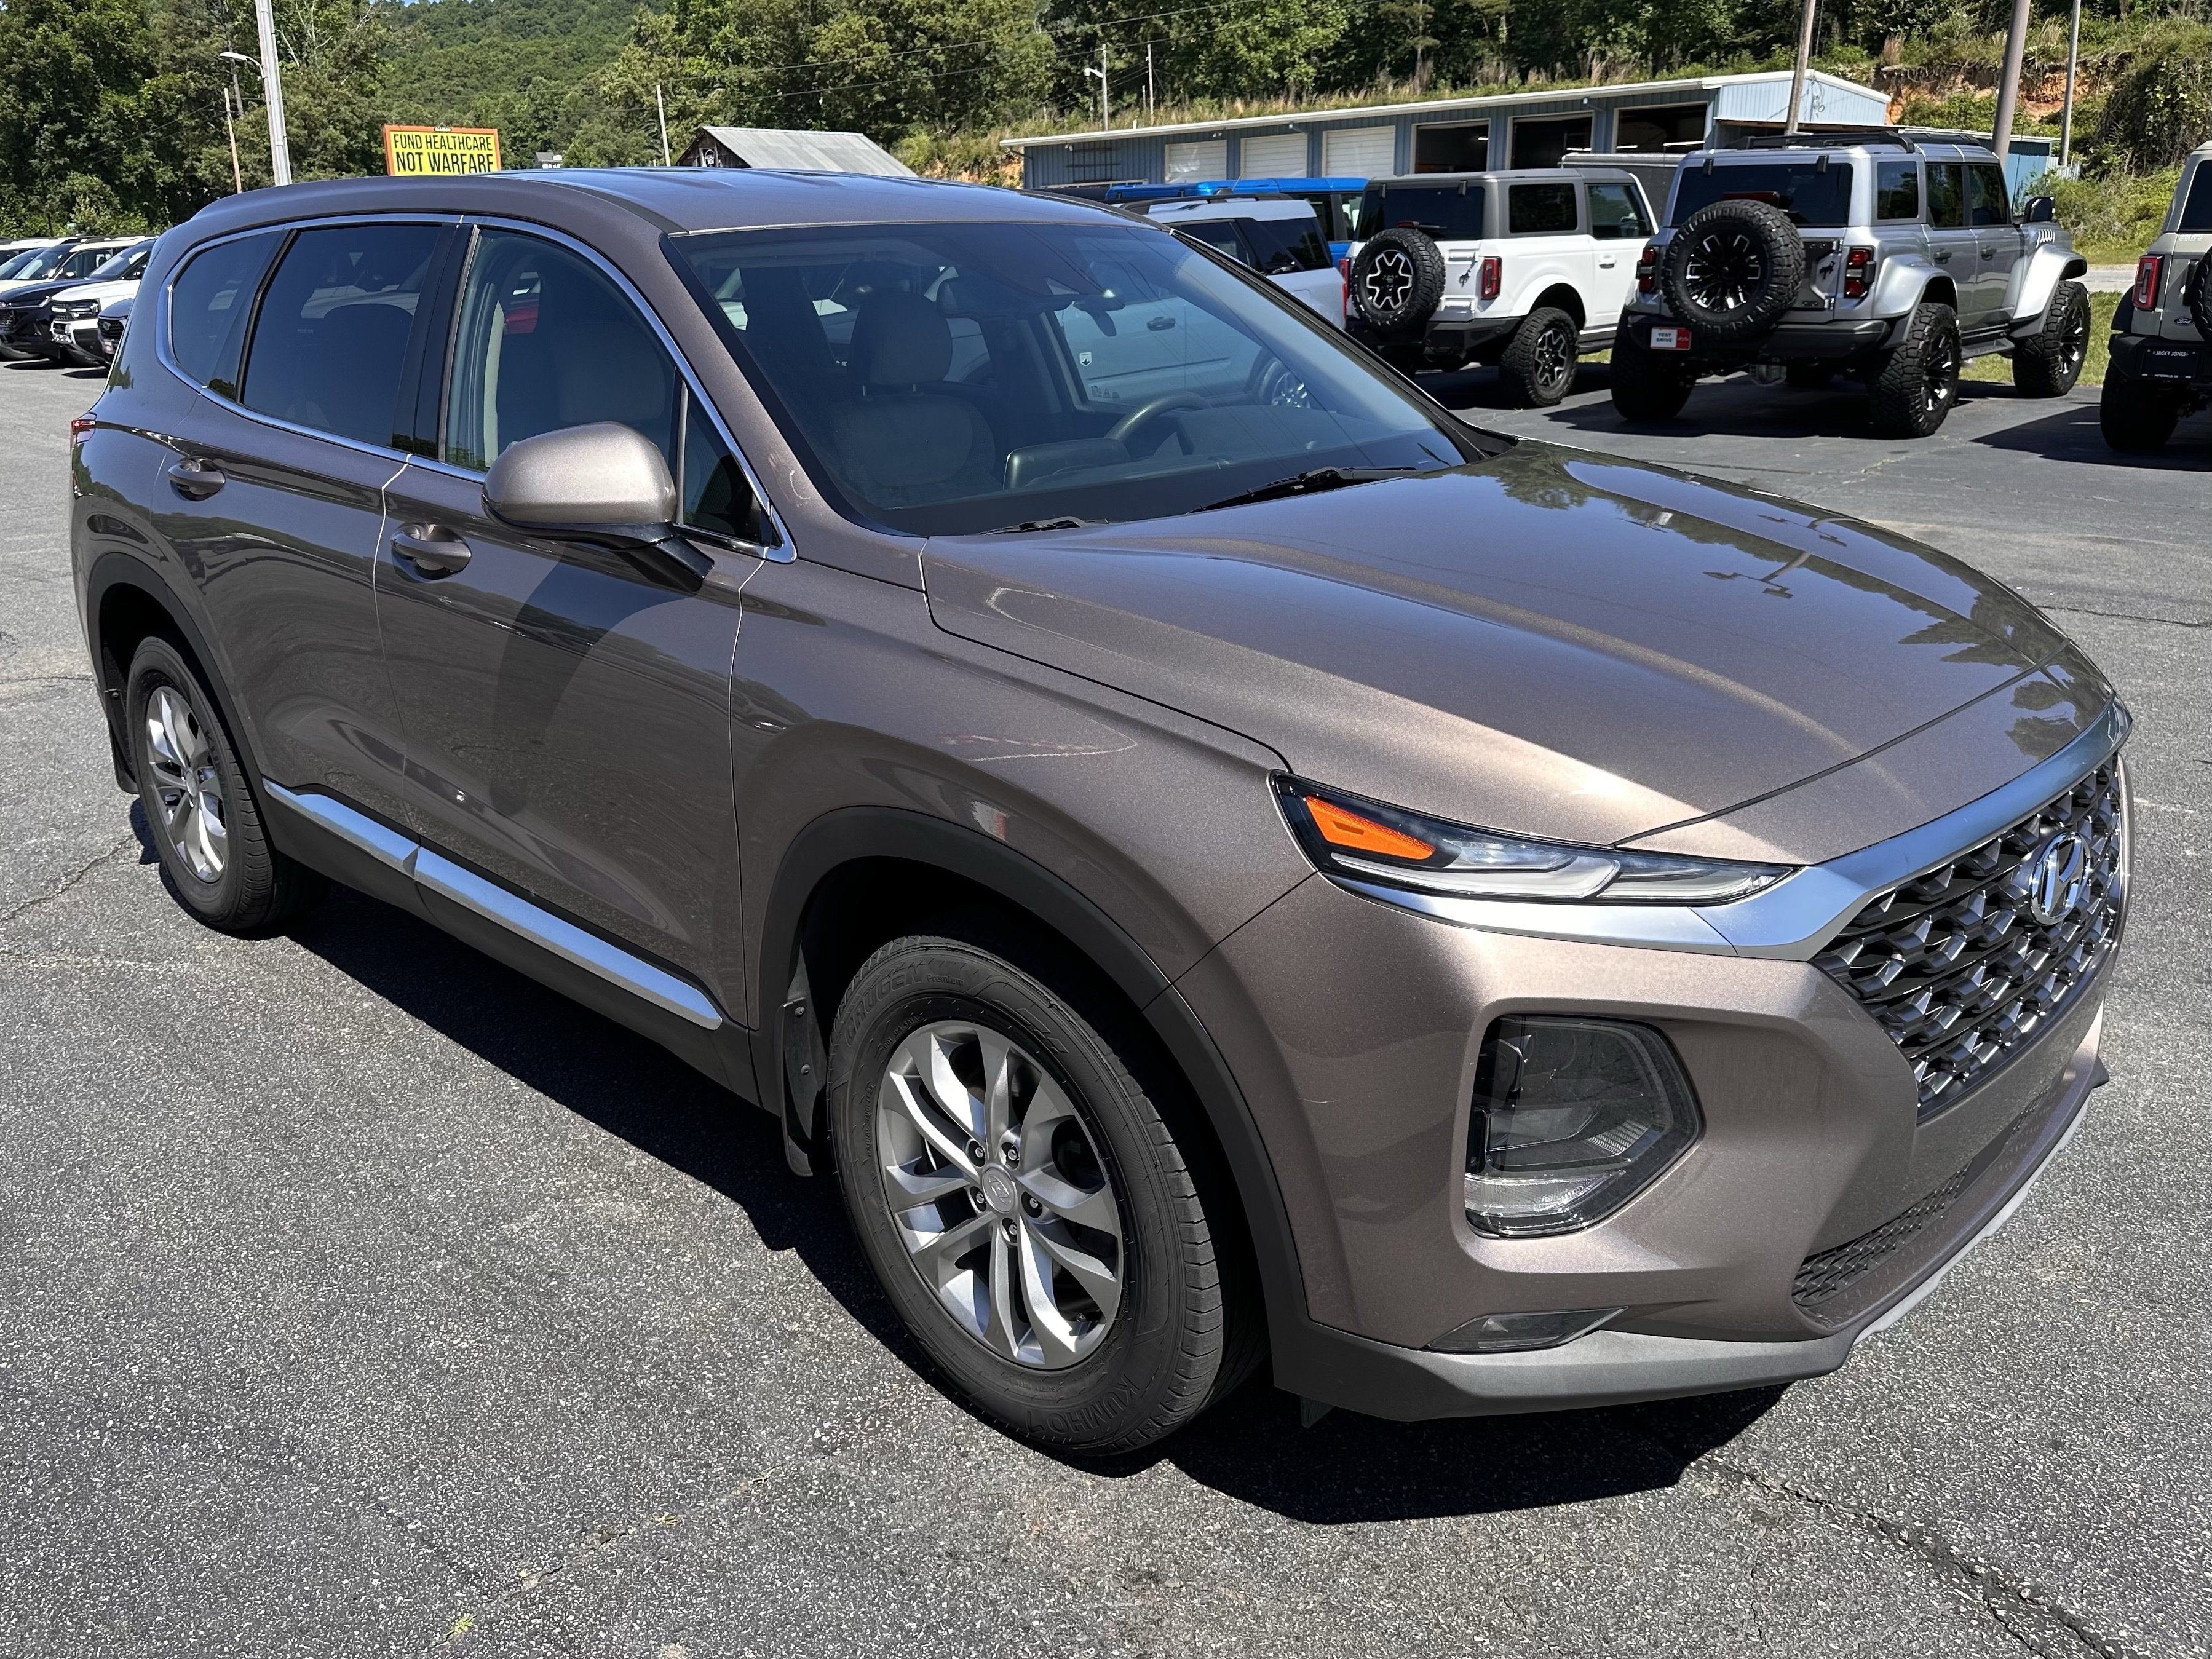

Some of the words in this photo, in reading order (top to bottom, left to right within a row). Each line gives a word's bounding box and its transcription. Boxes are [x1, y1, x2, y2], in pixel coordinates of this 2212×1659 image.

[394, 134, 422, 149] FUND
[425, 135, 493, 151] HEALTHCARE
[396, 152, 423, 172] NOT
[427, 152, 493, 174] WARFARE
[926, 973, 965, 987] Premium
[1047, 1374, 1140, 1434] KUMHO
